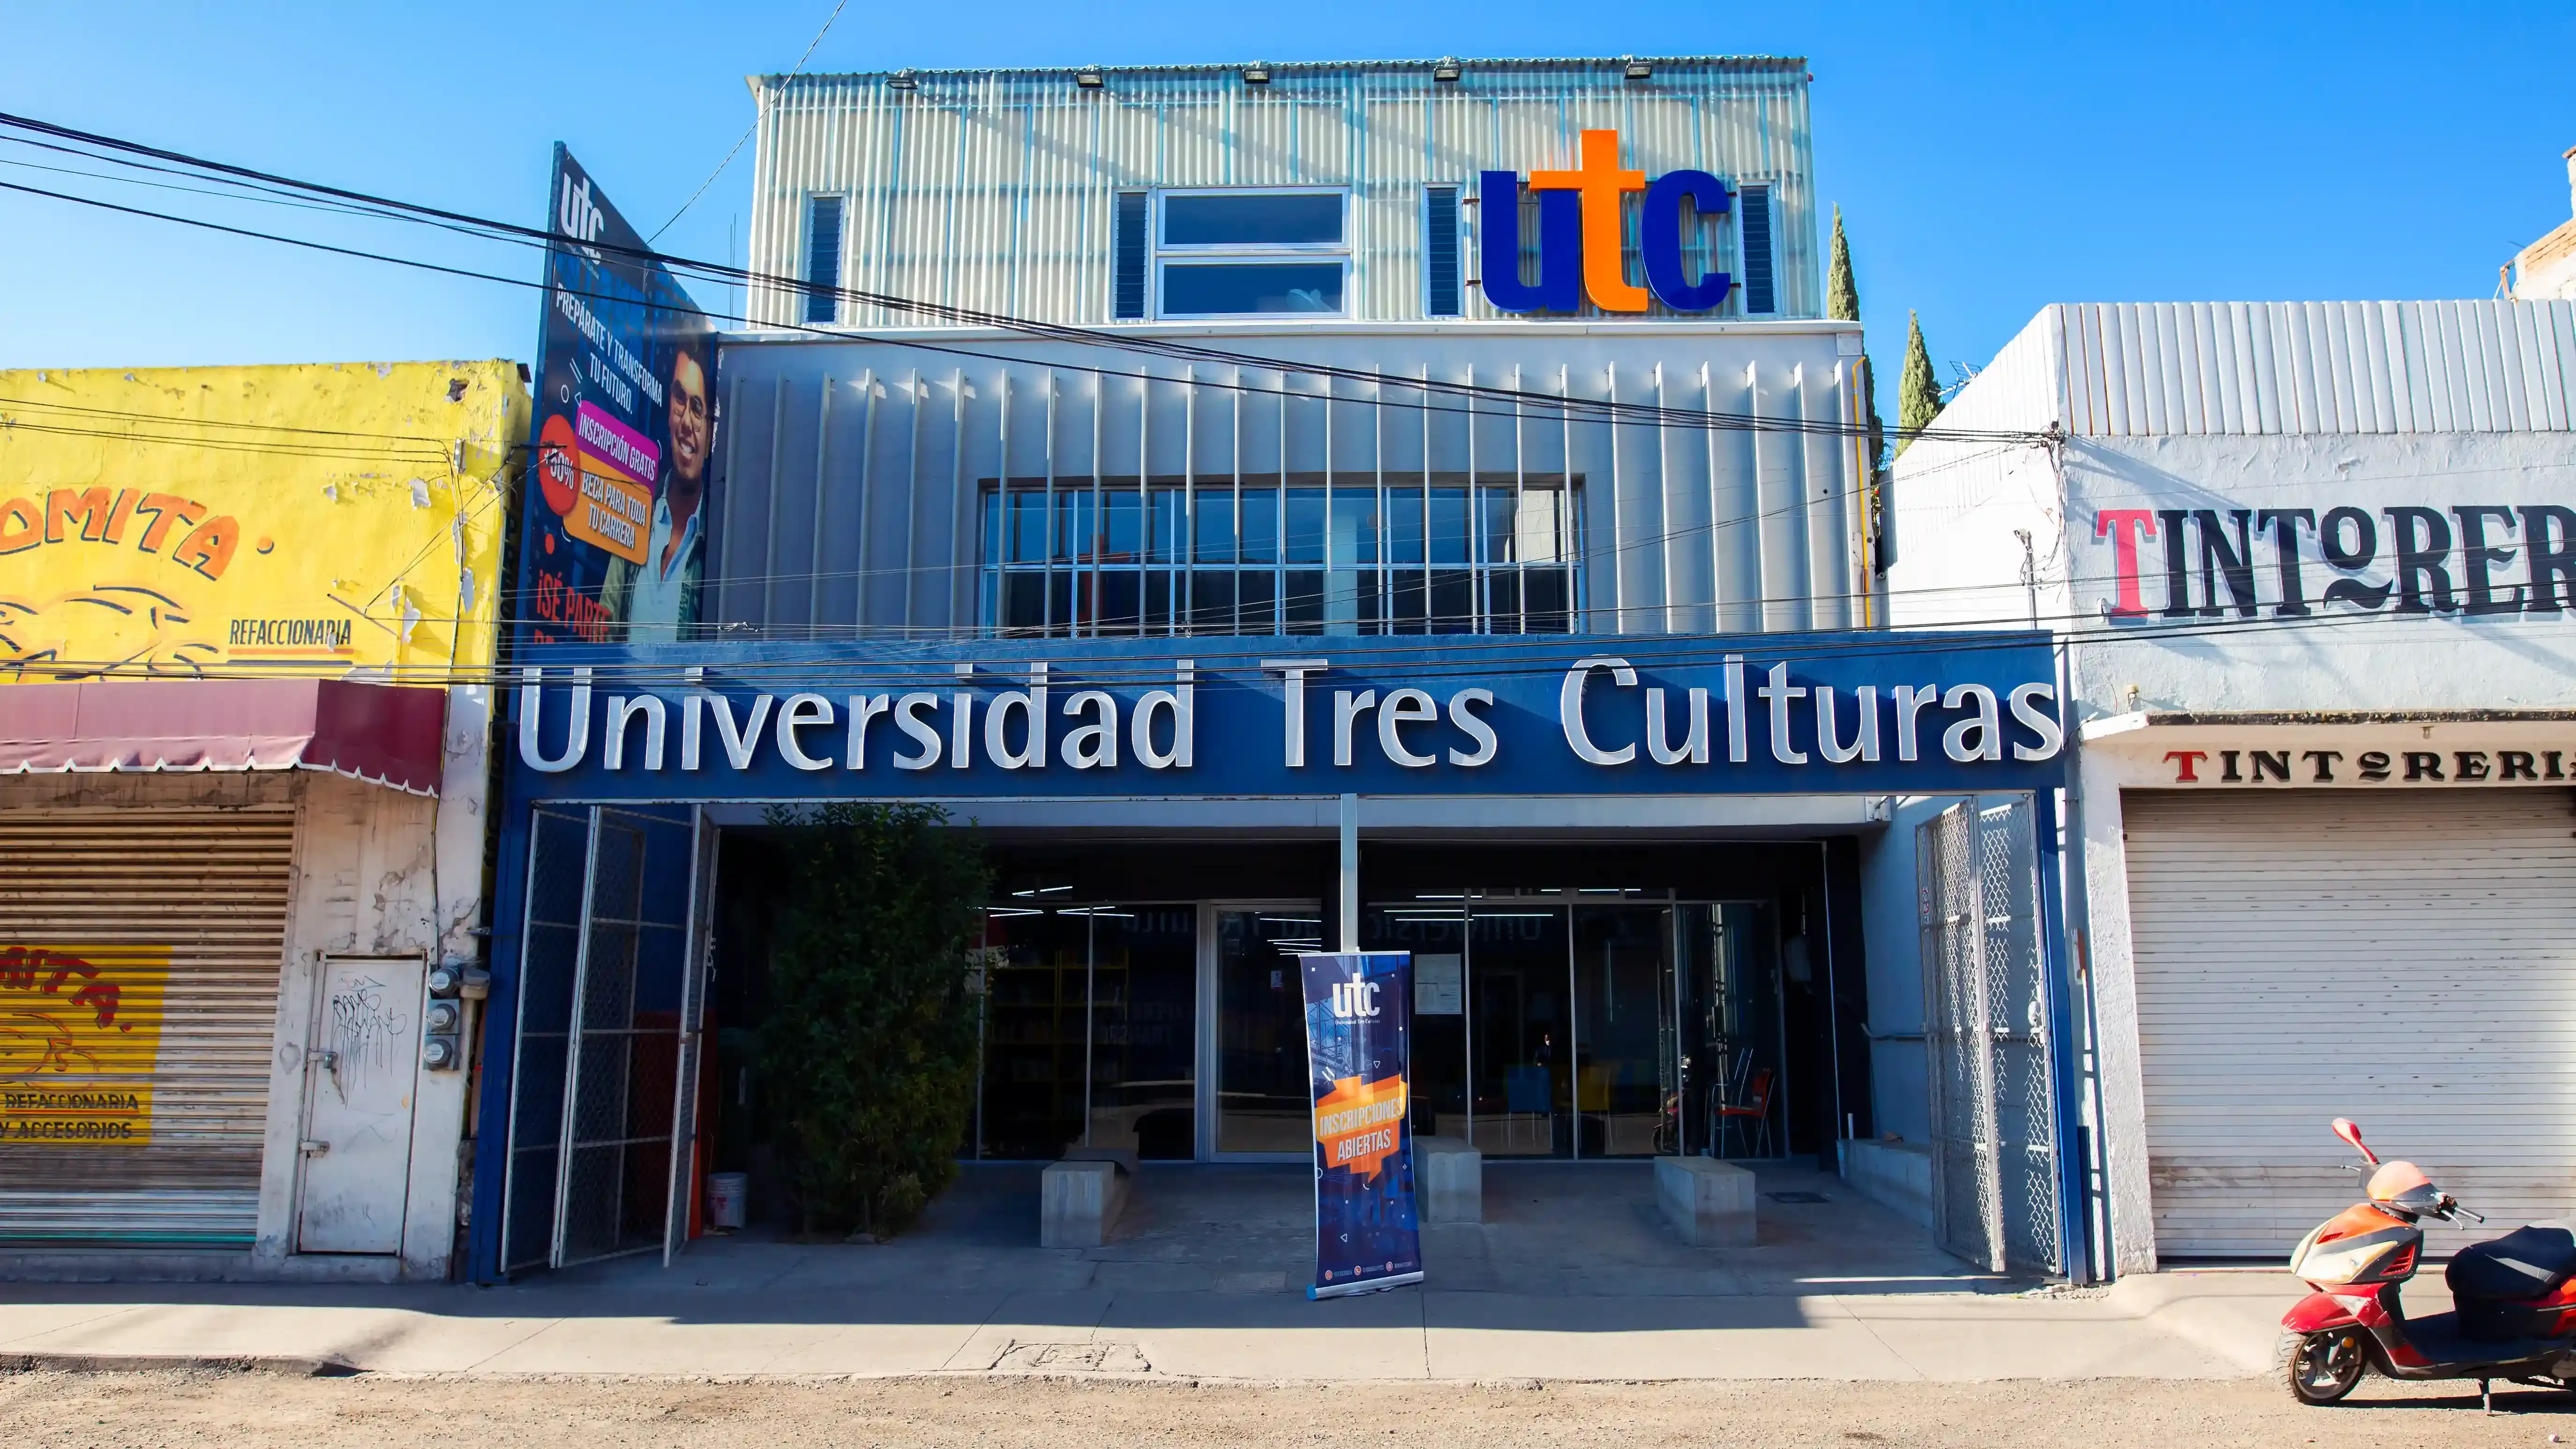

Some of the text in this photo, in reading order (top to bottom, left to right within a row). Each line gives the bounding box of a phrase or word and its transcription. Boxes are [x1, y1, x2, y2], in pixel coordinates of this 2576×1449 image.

[561, 173, 604, 265] utc
[1480, 129, 1731, 313] utc
[556, 282, 662, 407] PREPÁRATE Y TRANSFORMA
[590, 352, 632, 415] TU FUTURO.
[579, 413, 656, 481] INSCRIPCIÓN GRATIS
[582, 470, 646, 526] BECA PARA TODA
[589, 503, 635, 549] TU CARRERA
[229, 619, 351, 645] REFACCIONARIA
[565, 586, 613, 644] PARTE
[519, 654, 2064, 772] Universidad Tres Culturas
[2163, 750, 2576, 782] TINTORERI
[1332, 973, 1380, 1018] utc
[5, 1094, 139, 1109] REFACCIONARIA
[1320, 1097, 1403, 1137] INSCRIPCIONES
[15, 1121, 133, 1139] ACCESORIOS
[1338, 1129, 1391, 1161] ABIERTAS
